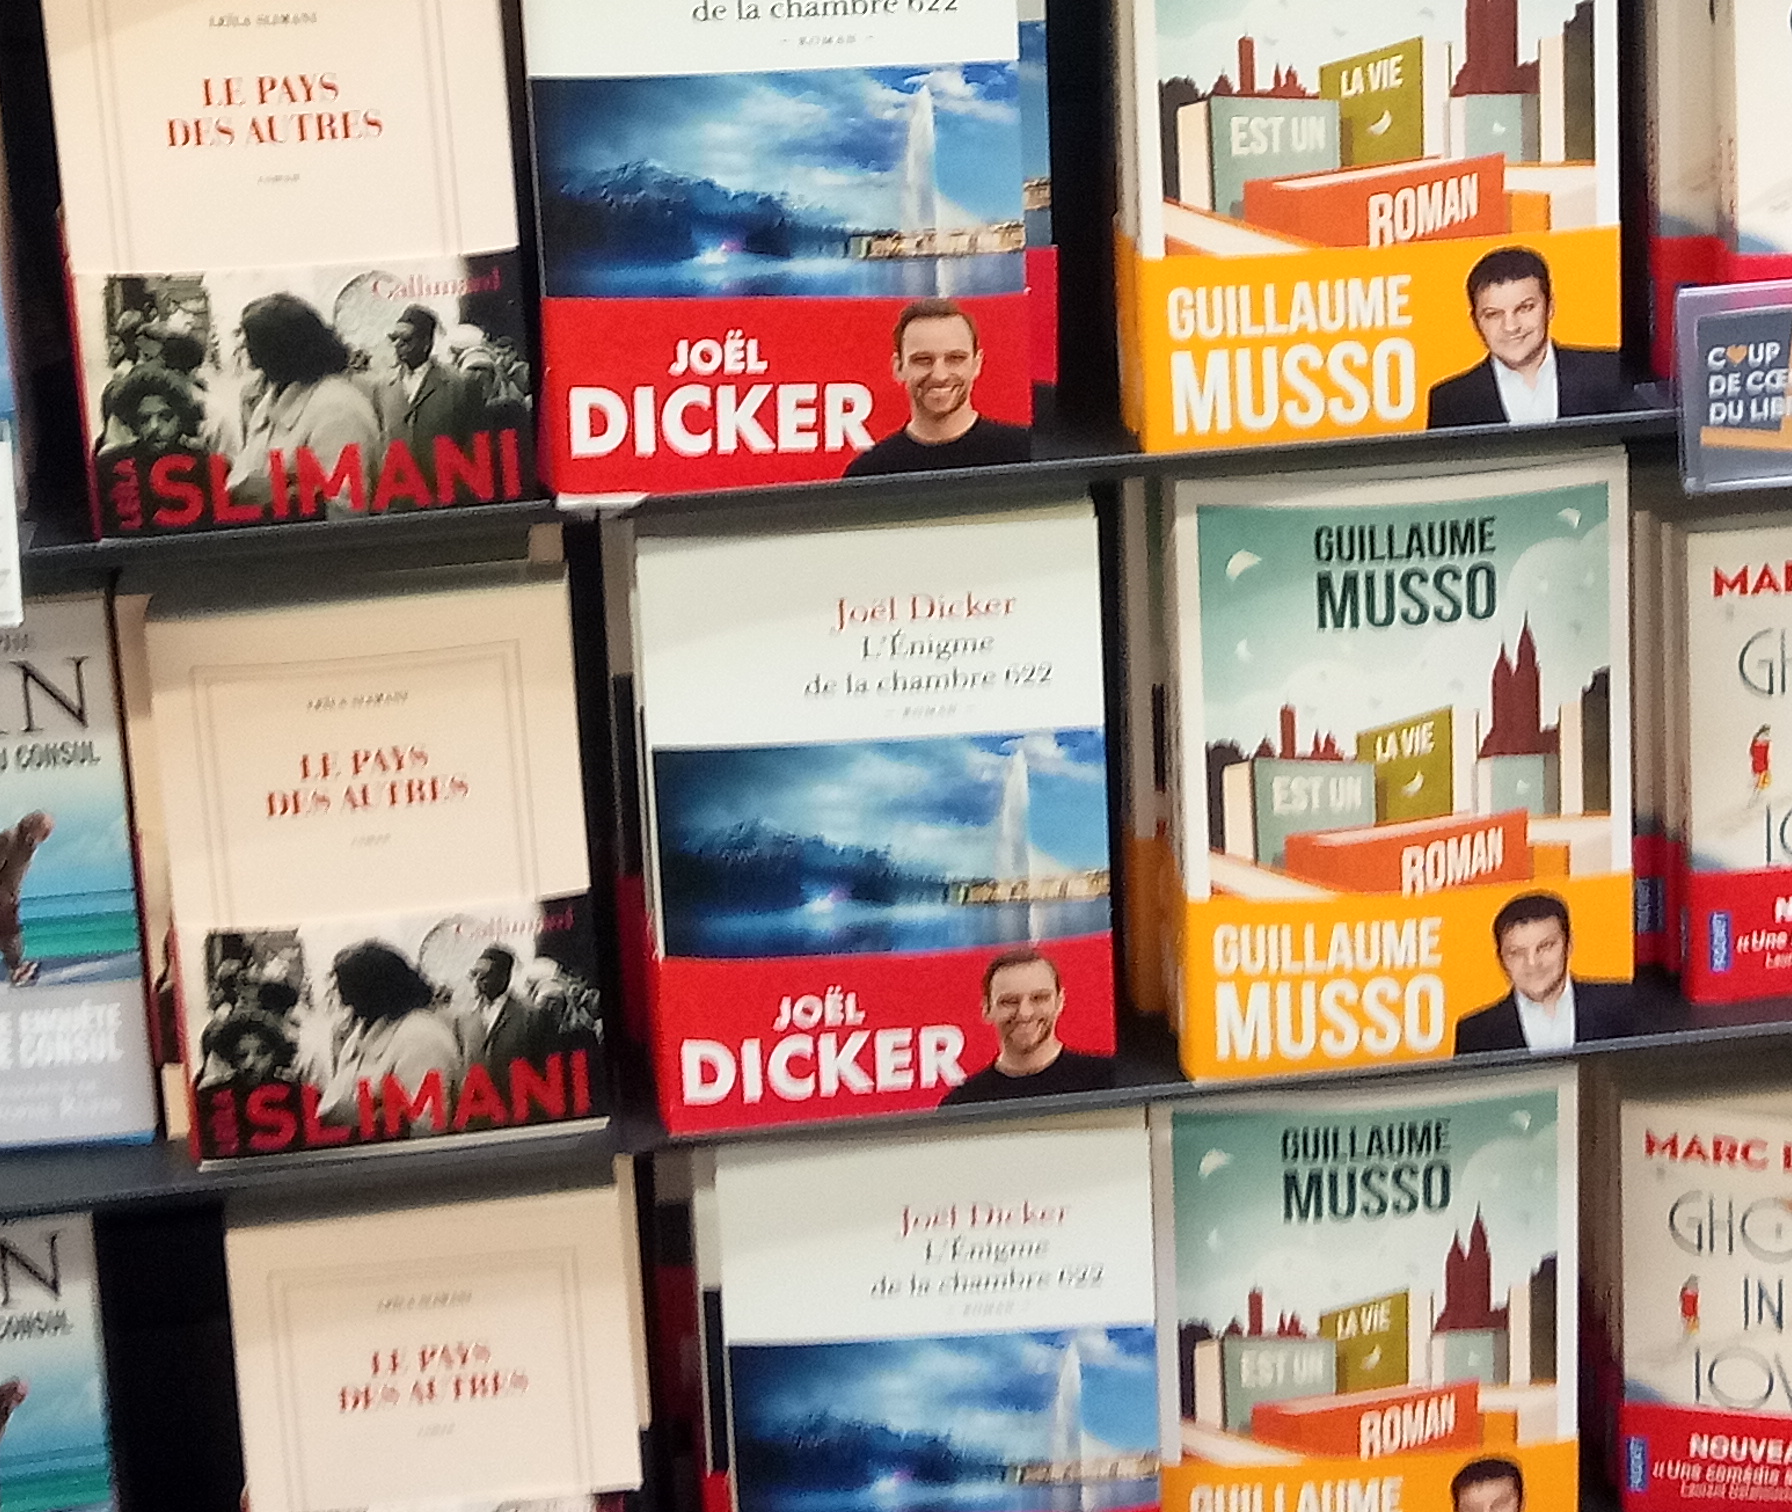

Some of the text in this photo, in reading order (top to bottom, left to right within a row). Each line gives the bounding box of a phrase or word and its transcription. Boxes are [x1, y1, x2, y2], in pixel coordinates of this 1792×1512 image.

[202, 72, 340, 108] LE PAYS
[1340, 54, 1403, 99] LA VIE
[167, 109, 383, 149] DES AUTRES
[1230, 114, 1325, 156] EST UN
[1367, 174, 1478, 248] ROMAN
[1167, 274, 1413, 340] GUILLAUME
[669, 330, 767, 375] JOËL
[1171, 338, 1417, 435] MUSSO
[1709, 399, 1744, 425] DU
[569, 383, 877, 460] DICKER
[147, 428, 521, 527] SLIMANI
[1315, 515, 1496, 563] GUILLAUME
[1316, 563, 1496, 632] MUSSO
[1213, 916, 1443, 976] GUILLAUME
[1215, 972, 1445, 1063] MUSSO
[679, 1023, 968, 1108] DICKER
[244, 1047, 592, 1153] SLIMANI
[1281, 1161, 1450, 1226] MUSSO
